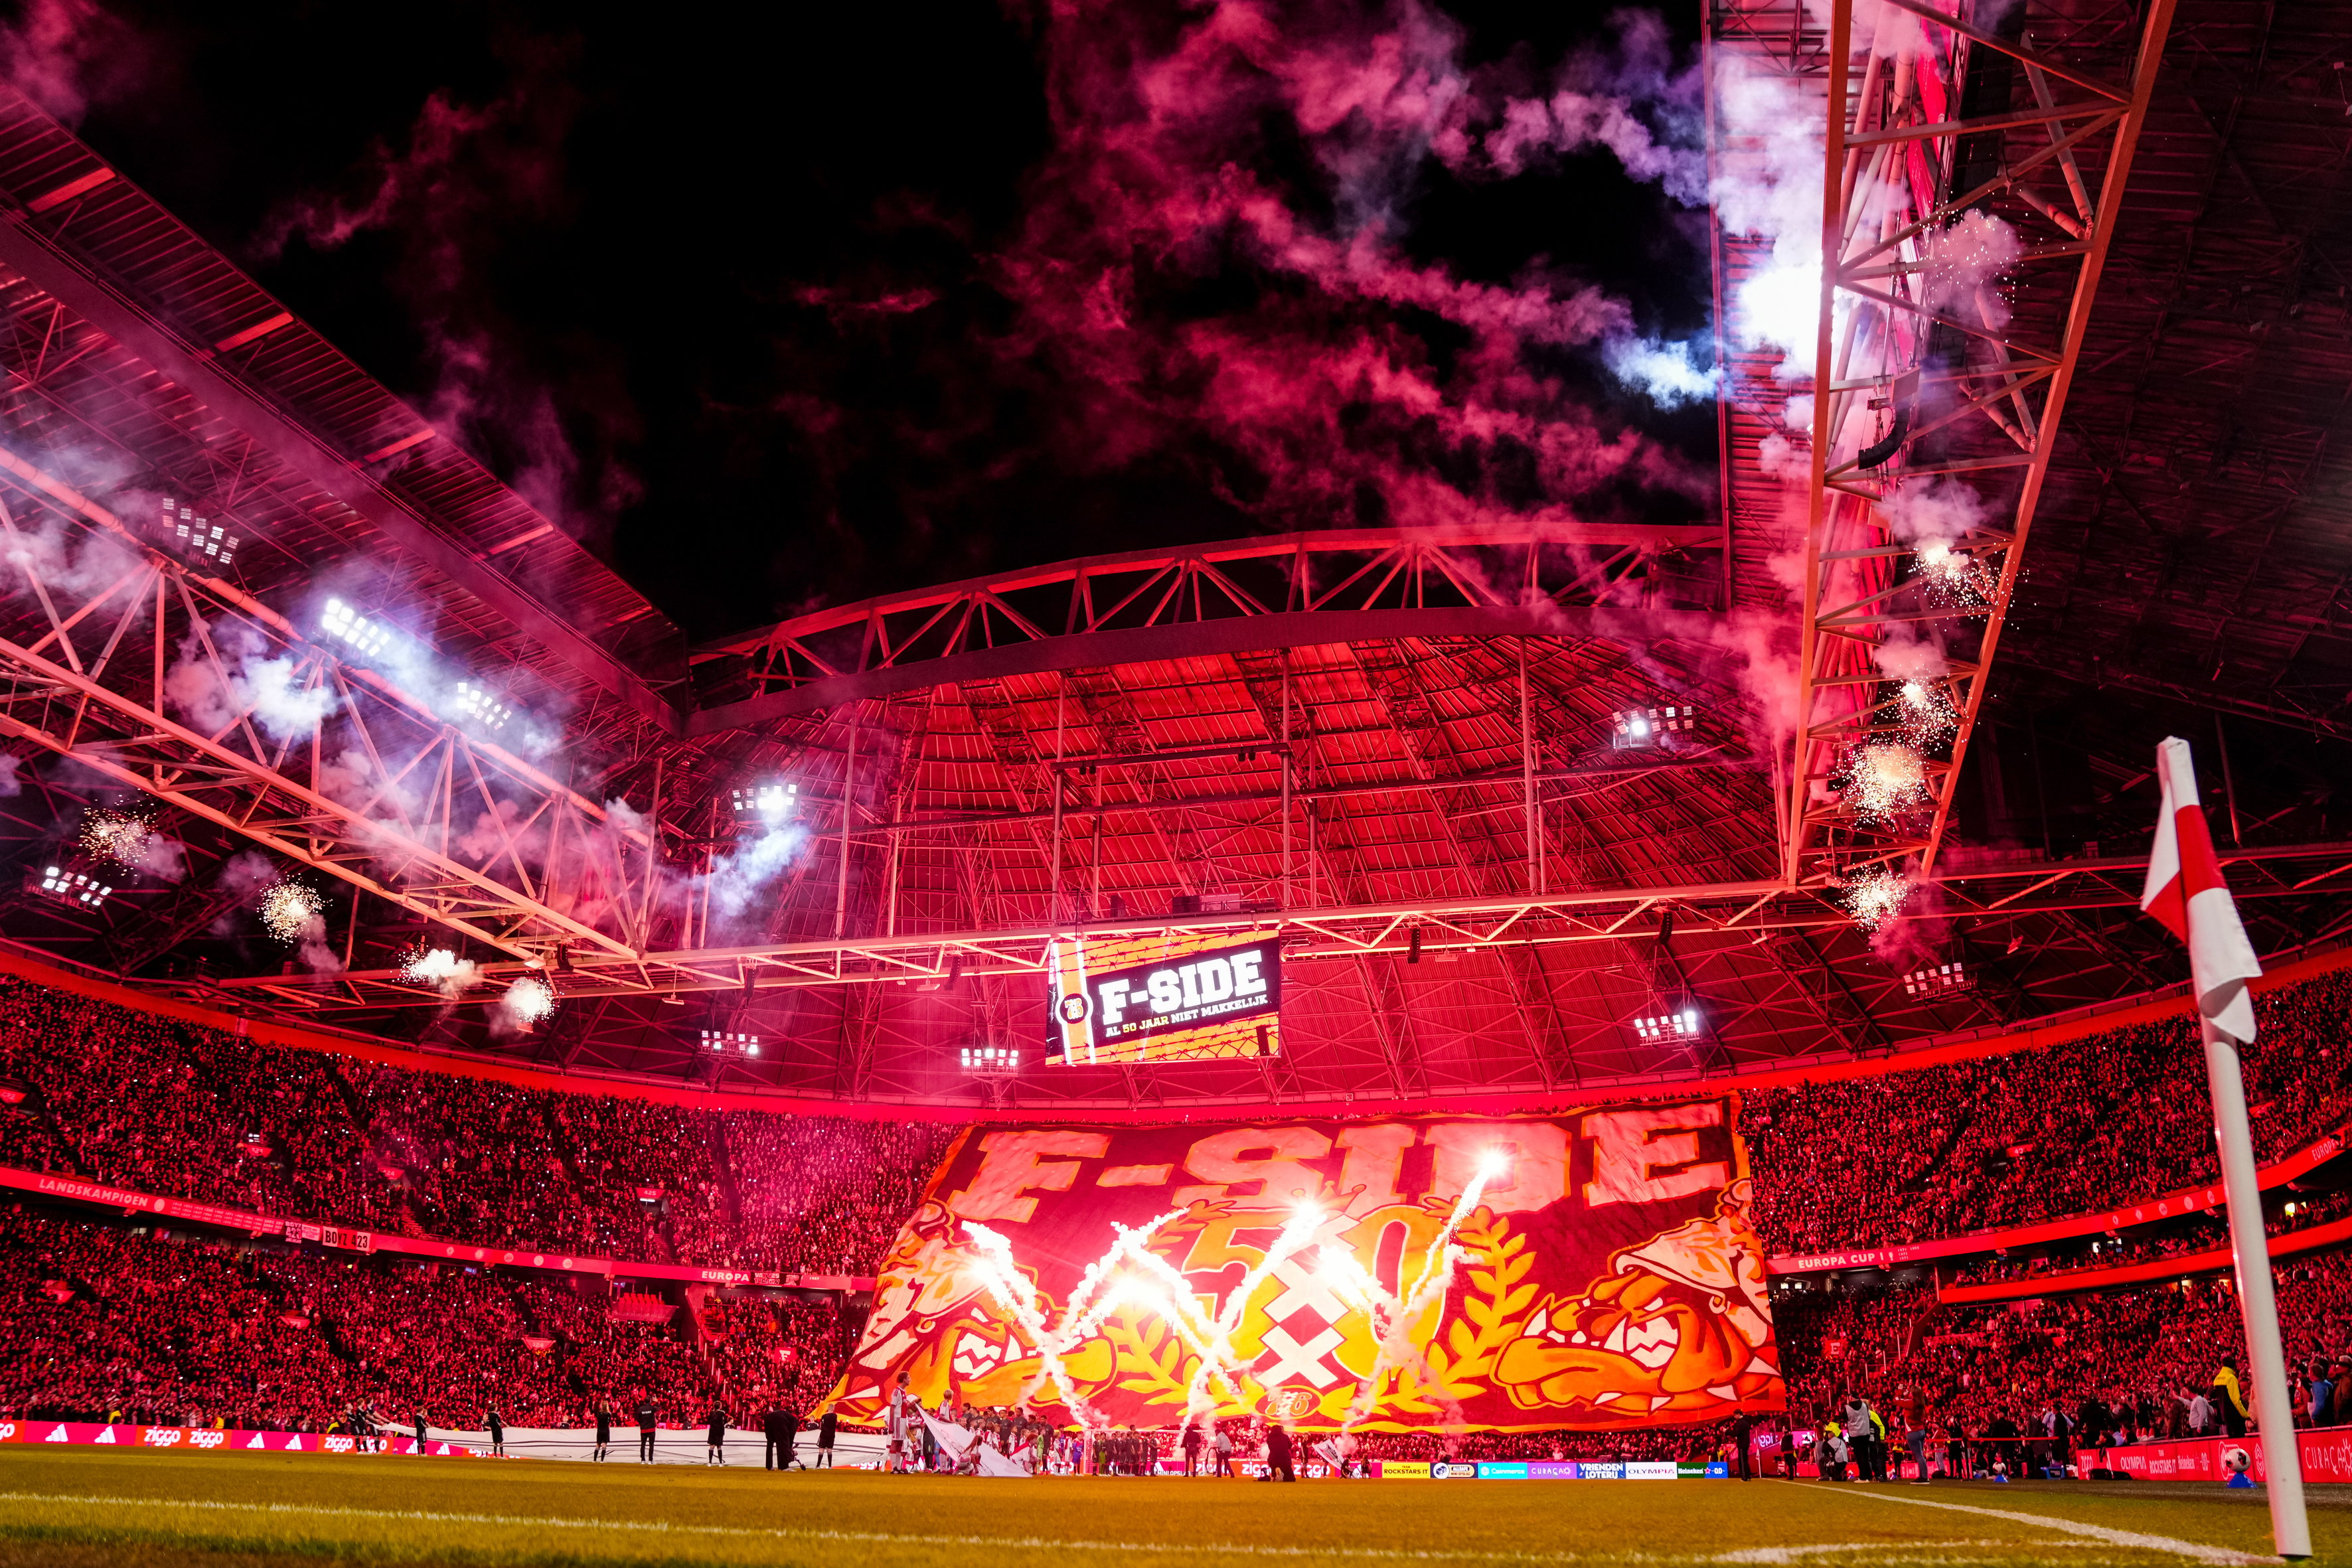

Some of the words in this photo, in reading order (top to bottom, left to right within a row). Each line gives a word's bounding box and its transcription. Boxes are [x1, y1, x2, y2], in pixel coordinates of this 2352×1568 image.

[1099, 949, 1267, 1025] F-SIDE
[1106, 1026, 1121, 1038] AL
[1123, 1021, 1137, 1033] 50
[1139, 1016, 1170, 1030] JAAR
[1171, 1009, 1199, 1024] NIET
[1201, 994, 1269, 1018] MAKKELIJK
[947, 1101, 1729, 1223] F-SIDE
[39, 1178, 148, 1207] LANDSKAMPIOEN
[325, 1229, 347, 1246] BOYZ
[351, 1234, 368, 1248] 423
[1798, 1256, 1846, 1269] EUROPA
[1850, 1253, 1875, 1263] CUP
[702, 1271, 749, 1282] EUROPA
[779, 1350, 791, 1362] F
[1830, 1342, 1840, 1354] E
[144, 1427, 181, 1447] ziggo
[189, 1428, 224, 1448] ziggo
[324, 1435, 353, 1452] ziggo
[1579, 1463, 1623, 1472] VRIENDEN
[2120, 1455, 2147, 1470] OLYMPIA
[2150, 1460, 2172, 1474] ROCKSTARS
[2172, 1459, 2177, 1473] IT
[2177, 1454, 2195, 1470] Heineken
[1585, 1470, 1618, 1479] LOTERIJ
